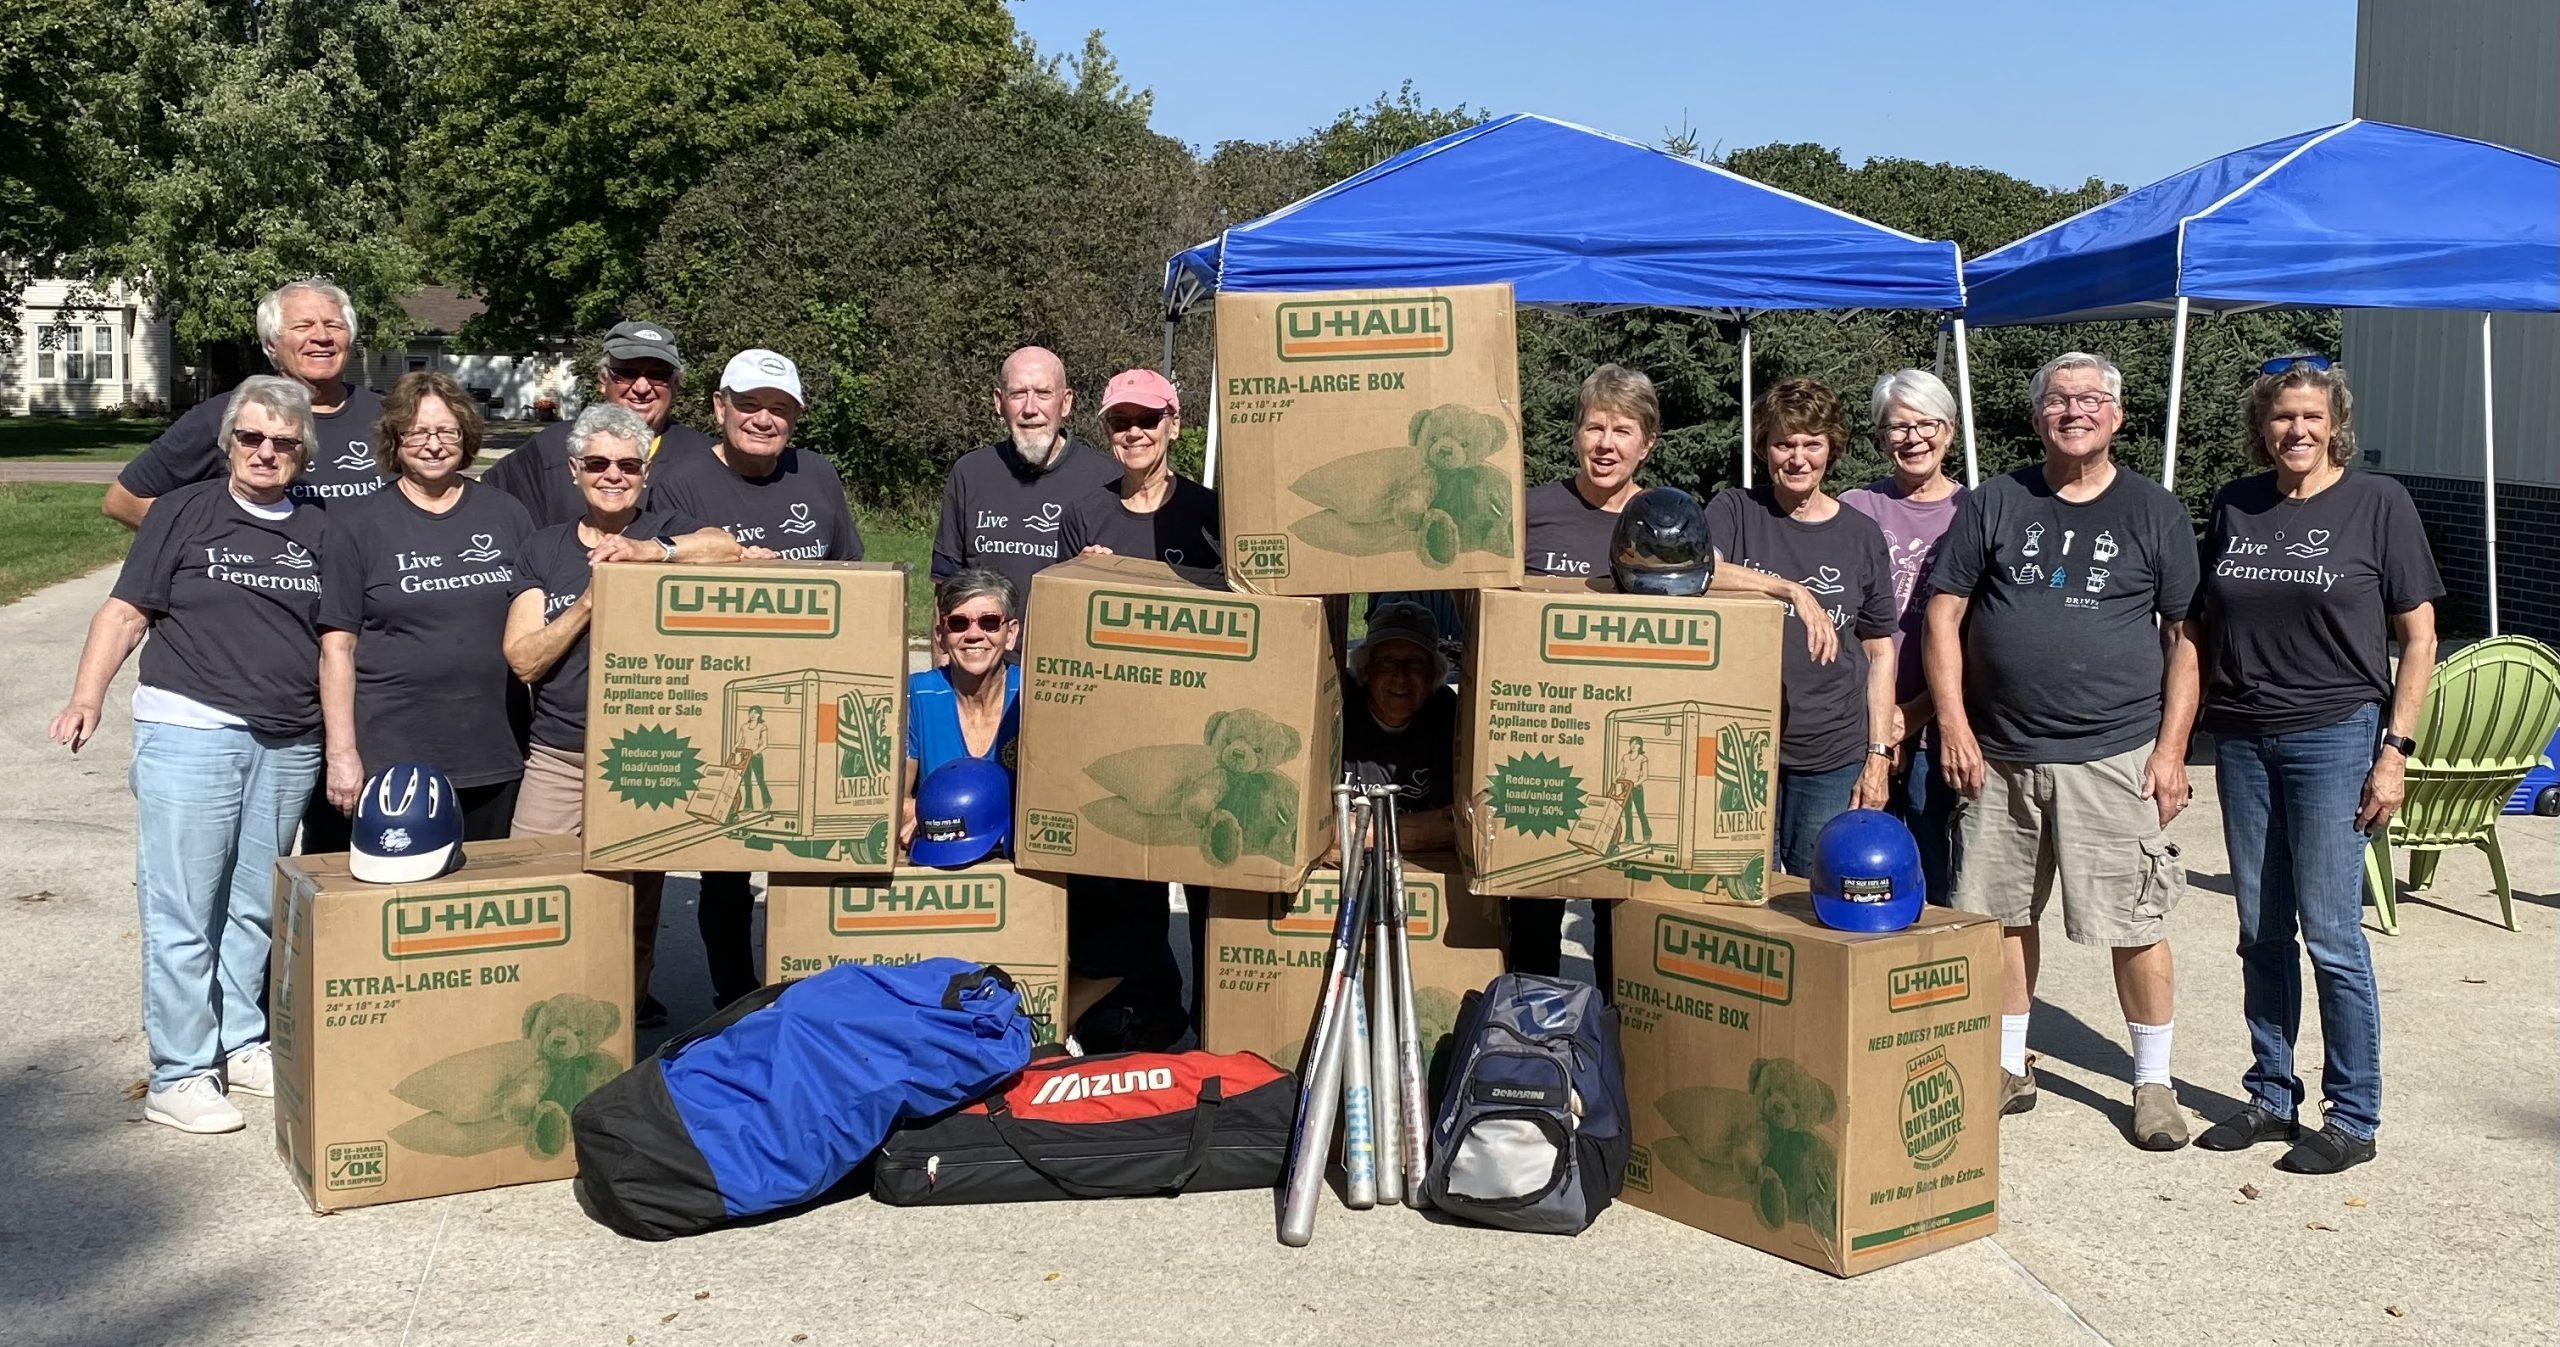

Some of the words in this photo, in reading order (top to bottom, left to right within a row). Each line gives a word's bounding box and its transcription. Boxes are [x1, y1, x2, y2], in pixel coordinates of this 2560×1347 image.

[1289, 308, 1441, 337] U-HAUL
[1228, 374, 1360, 396] EXTRA-LARGE
[1368, 372, 1405, 390] BOX
[1229, 399, 1245, 410] 24"
[1254, 399, 1270, 409] 18"
[1280, 399, 1295, 408] 24"
[1230, 413, 1248, 424] 6.0
[1251, 412, 1267, 423] CU
[1269, 412, 1283, 423] FT
[285, 476, 386, 497] enerousl
[976, 511, 1008, 529] Live
[205, 547, 255, 563] Live
[975, 535, 1058, 558] Generousl
[2226, 537, 2268, 555] Live
[395, 551, 443, 571] Live
[1255, 553, 1285, 567] OK
[1544, 552, 1591, 574] Live
[2216, 559, 2338, 592] Generously
[670, 585, 828, 615] U-HAUL
[1100, 600, 1247, 638] U-HAUL
[1554, 614, 1708, 646] U-HAUL
[605, 653, 648, 670] Save
[654, 654, 694, 670] Your
[701, 655, 751, 671] Back!
[604, 673, 662, 685] Furniture
[666, 674, 689, 686] and
[1036, 657, 1163, 685] EXTRA-LARGE
[1169, 669, 1207, 689] BOX
[1035, 679, 1050, 688] 24"
[1083, 683, 1098, 692] 24"
[1490, 680, 1532, 697] Save
[1538, 682, 1577, 699] Your
[1583, 684, 1632, 701] Back!
[603, 688, 664, 702] Appliance
[668, 689, 708, 701] Dollies
[1034, 691, 1051, 702] 6.0
[1054, 692, 1069, 703] CU
[1071, 694, 1085, 705] FT
[603, 703, 621, 715] for
[625, 704, 654, 716] Rent
[657, 706, 672, 716] or
[675, 705, 702, 717] Sale
[1490, 700, 1545, 713] Furniture
[1549, 702, 1572, 714] and
[1489, 715, 1547, 730] Appliance
[1551, 717, 1591, 730] Dollies
[1489, 729, 1506, 741] for
[1510, 730, 1538, 743] Rent
[1541, 734, 1555, 744] or
[1558, 733, 1584, 746] Sale
[620, 747, 658, 758] Reduce
[660, 749, 683, 761] your
[621, 761, 681, 773] load/unload
[620, 776, 643, 787] time
[644, 777, 658, 789] by
[659, 776, 682, 787] 50%
[1505, 774, 1541, 787] Reduce
[1543, 777, 1565, 789] your
[1506, 789, 1563, 802] load/unload
[1504, 803, 1526, 815] time
[1528, 804, 1541, 817] by
[1542, 804, 1564, 816] 50%
[1044, 830, 1072, 845] OK
[842, 884, 994, 912] U-HAUL
[397, 897, 559, 935] U-HAUL
[1219, 946, 1333, 968] EXTRA-LARG
[1664, 925, 1783, 979] U-HAUL
[781, 955, 822, 971] Save
[325, 968, 472, 998] EXTRA-LARGE
[480, 964, 520, 985] BOX
[1219, 968, 1234, 977] 24"
[1267, 971, 1282, 980] 24"
[1894, 965, 1964, 995] U-HAUL
[1219, 980, 1236, 990] 6.0
[1239, 980, 1254, 992] CU
[1256, 982, 1270, 993] FT
[325, 1002, 343, 1013] 24"
[355, 1001, 372, 1011] 18"
[383, 999, 400, 1009] 24"
[1617, 978, 1713, 1021] EXTRA-LARGE
[1719, 1005, 1750, 1031] BOX
[326, 1015, 347, 1028] 6.0
[350, 1014, 367, 1026] CU
[370, 1012, 387, 1025] FT
[1631, 1018, 1641, 1030] CU
[1643, 1023, 1654, 1034] FT
[1868, 1035, 1893, 1052] NEED
[1896, 1027, 1931, 1047] BOXES?
[1933, 1022, 1955, 1039] TAKE
[1957, 1015, 1991, 1034] PLENTY!
[1907, 1067, 1953, 1114] 100%
[1905, 1096, 1961, 1139] BUY-BACK
[349, 1160, 381, 1177] OK
[1627, 1162, 1648, 1181] OK
[1870, 1187, 1895, 1205] We'll
[1896, 1185, 1914, 1199] Buy
[1916, 1177, 1938, 1194] Back
[1940, 1173, 1954, 1187] the
[1956, 1167, 1985, 1183] Extras.
